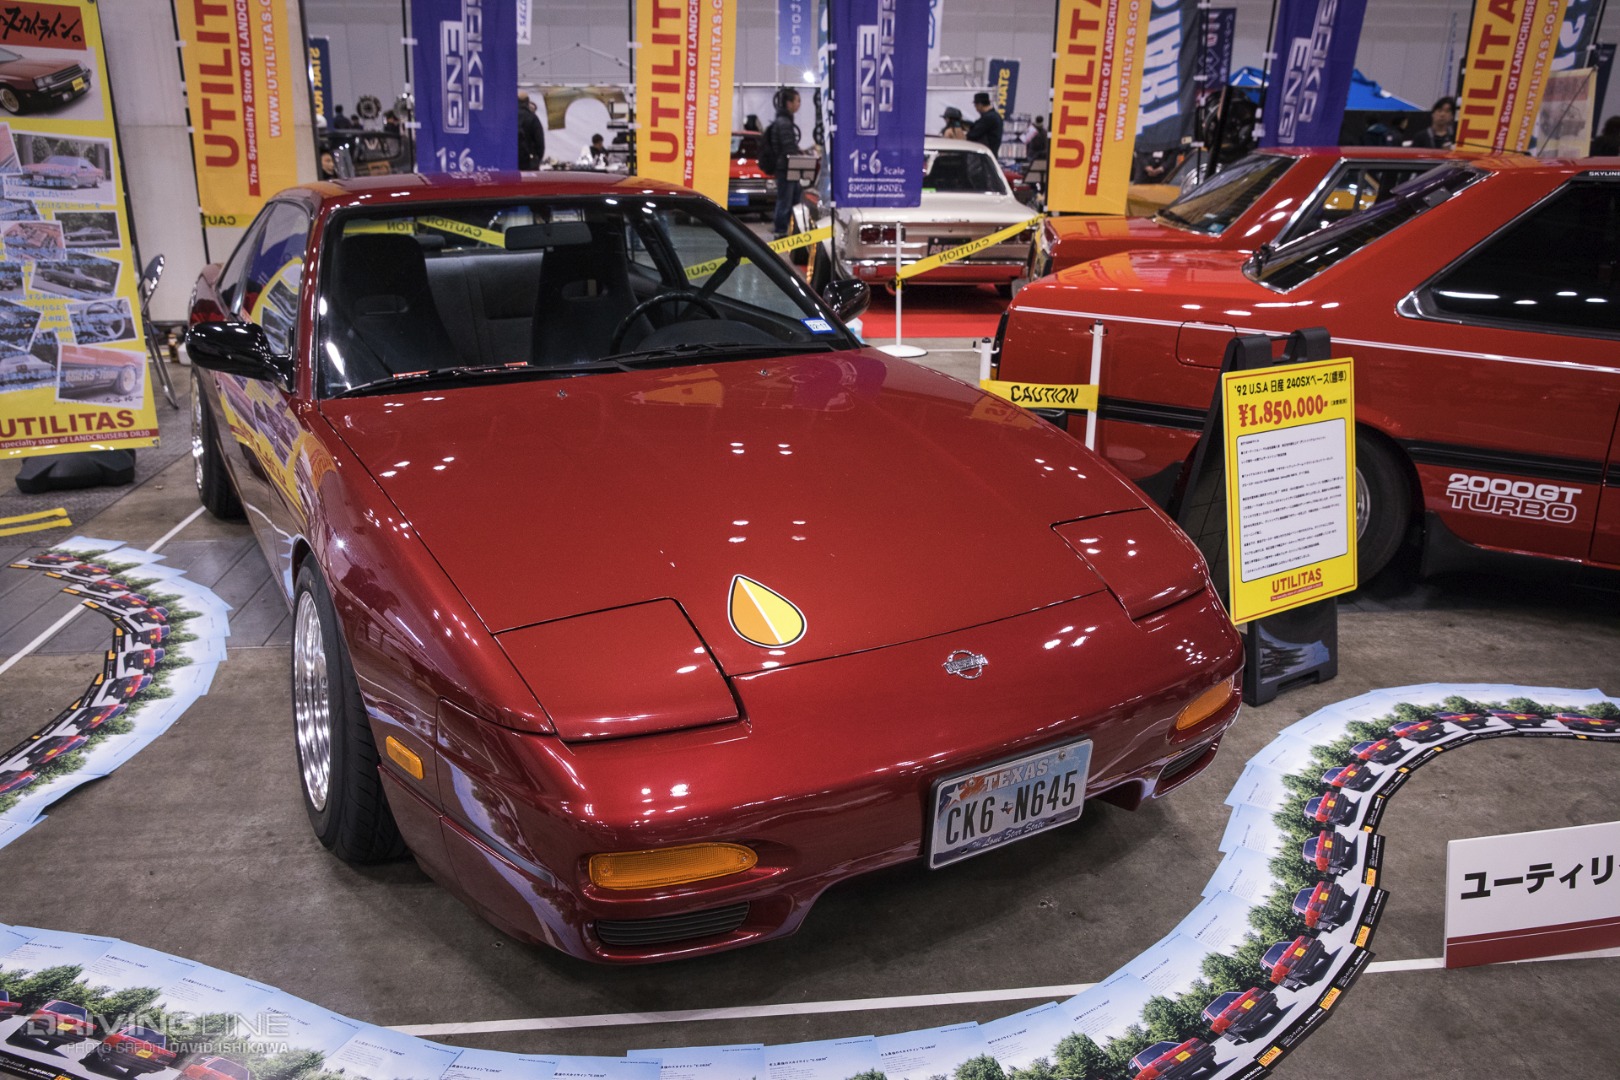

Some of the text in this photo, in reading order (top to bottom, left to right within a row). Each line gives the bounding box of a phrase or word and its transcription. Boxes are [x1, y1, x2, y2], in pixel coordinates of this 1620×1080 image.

[241, 51, 251, 66] Of
[688, 52, 697, 67] Of
[1102, 62, 1111, 77] Of
[243, 70, 253, 103] Store
[444, 22, 466, 131] ENG
[687, 69, 696, 102] Store
[859, 26, 877, 132] ENG
[1098, 78, 1109, 110] Store
[1501, 92, 1515, 123] Store
[1508, 77, 1517, 91] Of
[244, 107, 257, 166] Specialty
[685, 105, 697, 157] Specialty
[1092, 112, 1106, 163] Specialty
[437, 147, 475, 172] 1:6
[684, 159, 692, 180] The
[849, 150, 905, 175] 1:6 Scale
[249, 167, 258, 185] The
[1088, 167, 1097, 185] The
[1010, 385, 1079, 403] CAUTION
[1270, 378, 1284, 393] 日産
[0, 409, 135, 438] UTILITAS
[1, 438, 37, 449] specialty
[38, 436, 59, 445] store
[60, 435, 69, 443] of
[1447, 473, 1582, 504] 2000GT
[1446, 489, 1578, 524] TURBO
[1272, 568, 1322, 593] UTILITAS
[984, 758, 1049, 792] TEXAS
[982, 834, 1003, 848] Lone
[1004, 827, 1022, 840] Star
[1023, 821, 1045, 834] State
